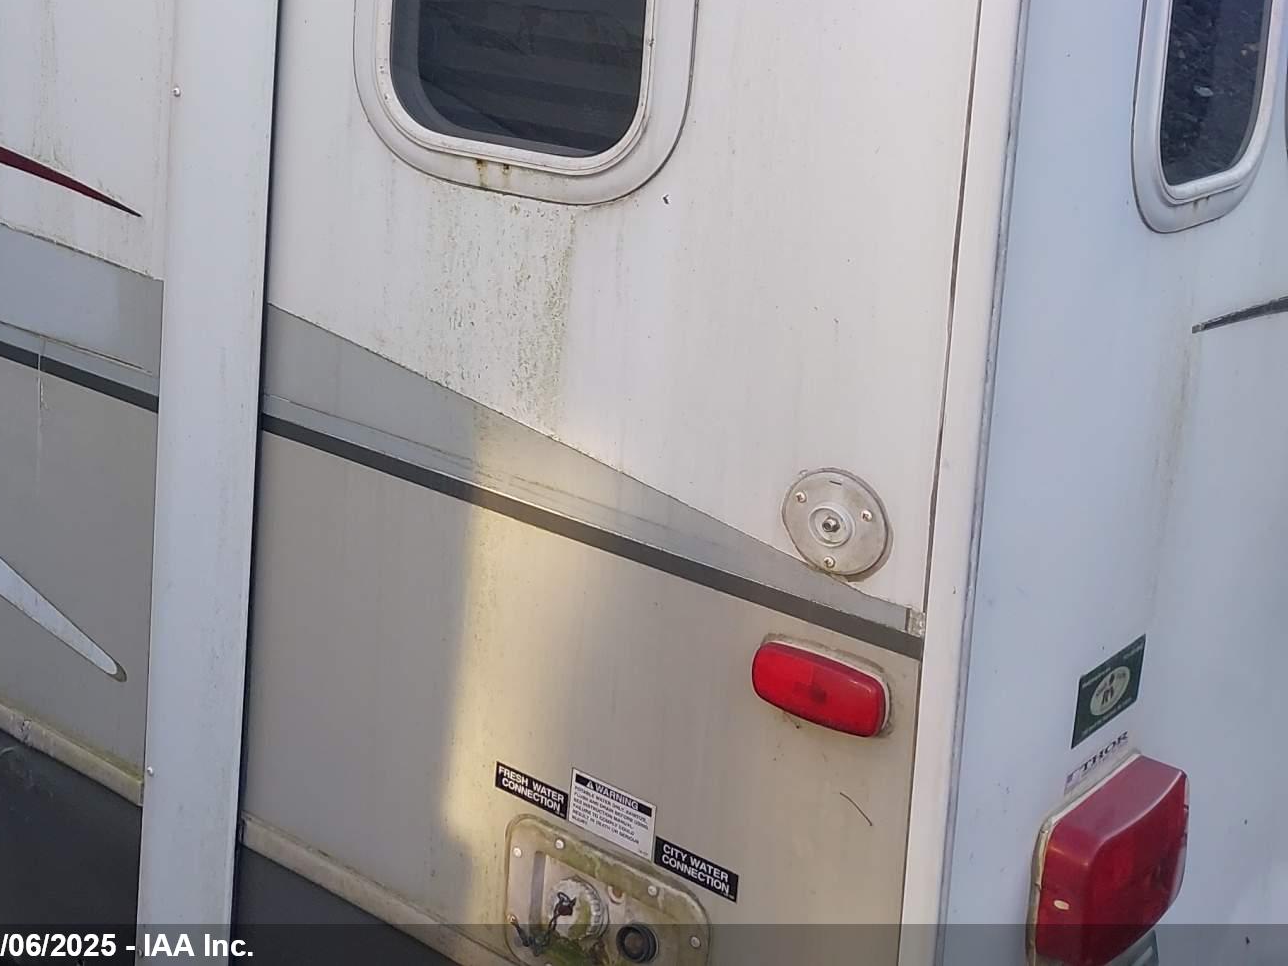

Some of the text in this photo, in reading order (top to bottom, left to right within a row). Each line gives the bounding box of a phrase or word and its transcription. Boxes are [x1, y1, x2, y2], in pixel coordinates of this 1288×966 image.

[1079, 730, 1128, 772] THOR
[498, 765, 565, 804] FRESH WATER
[502, 777, 561, 812] CONNECTION
[595, 783, 639, 810] WARNING
[662, 854, 730, 894] CONNECTION
[663, 843, 729, 882] CITY WATER
